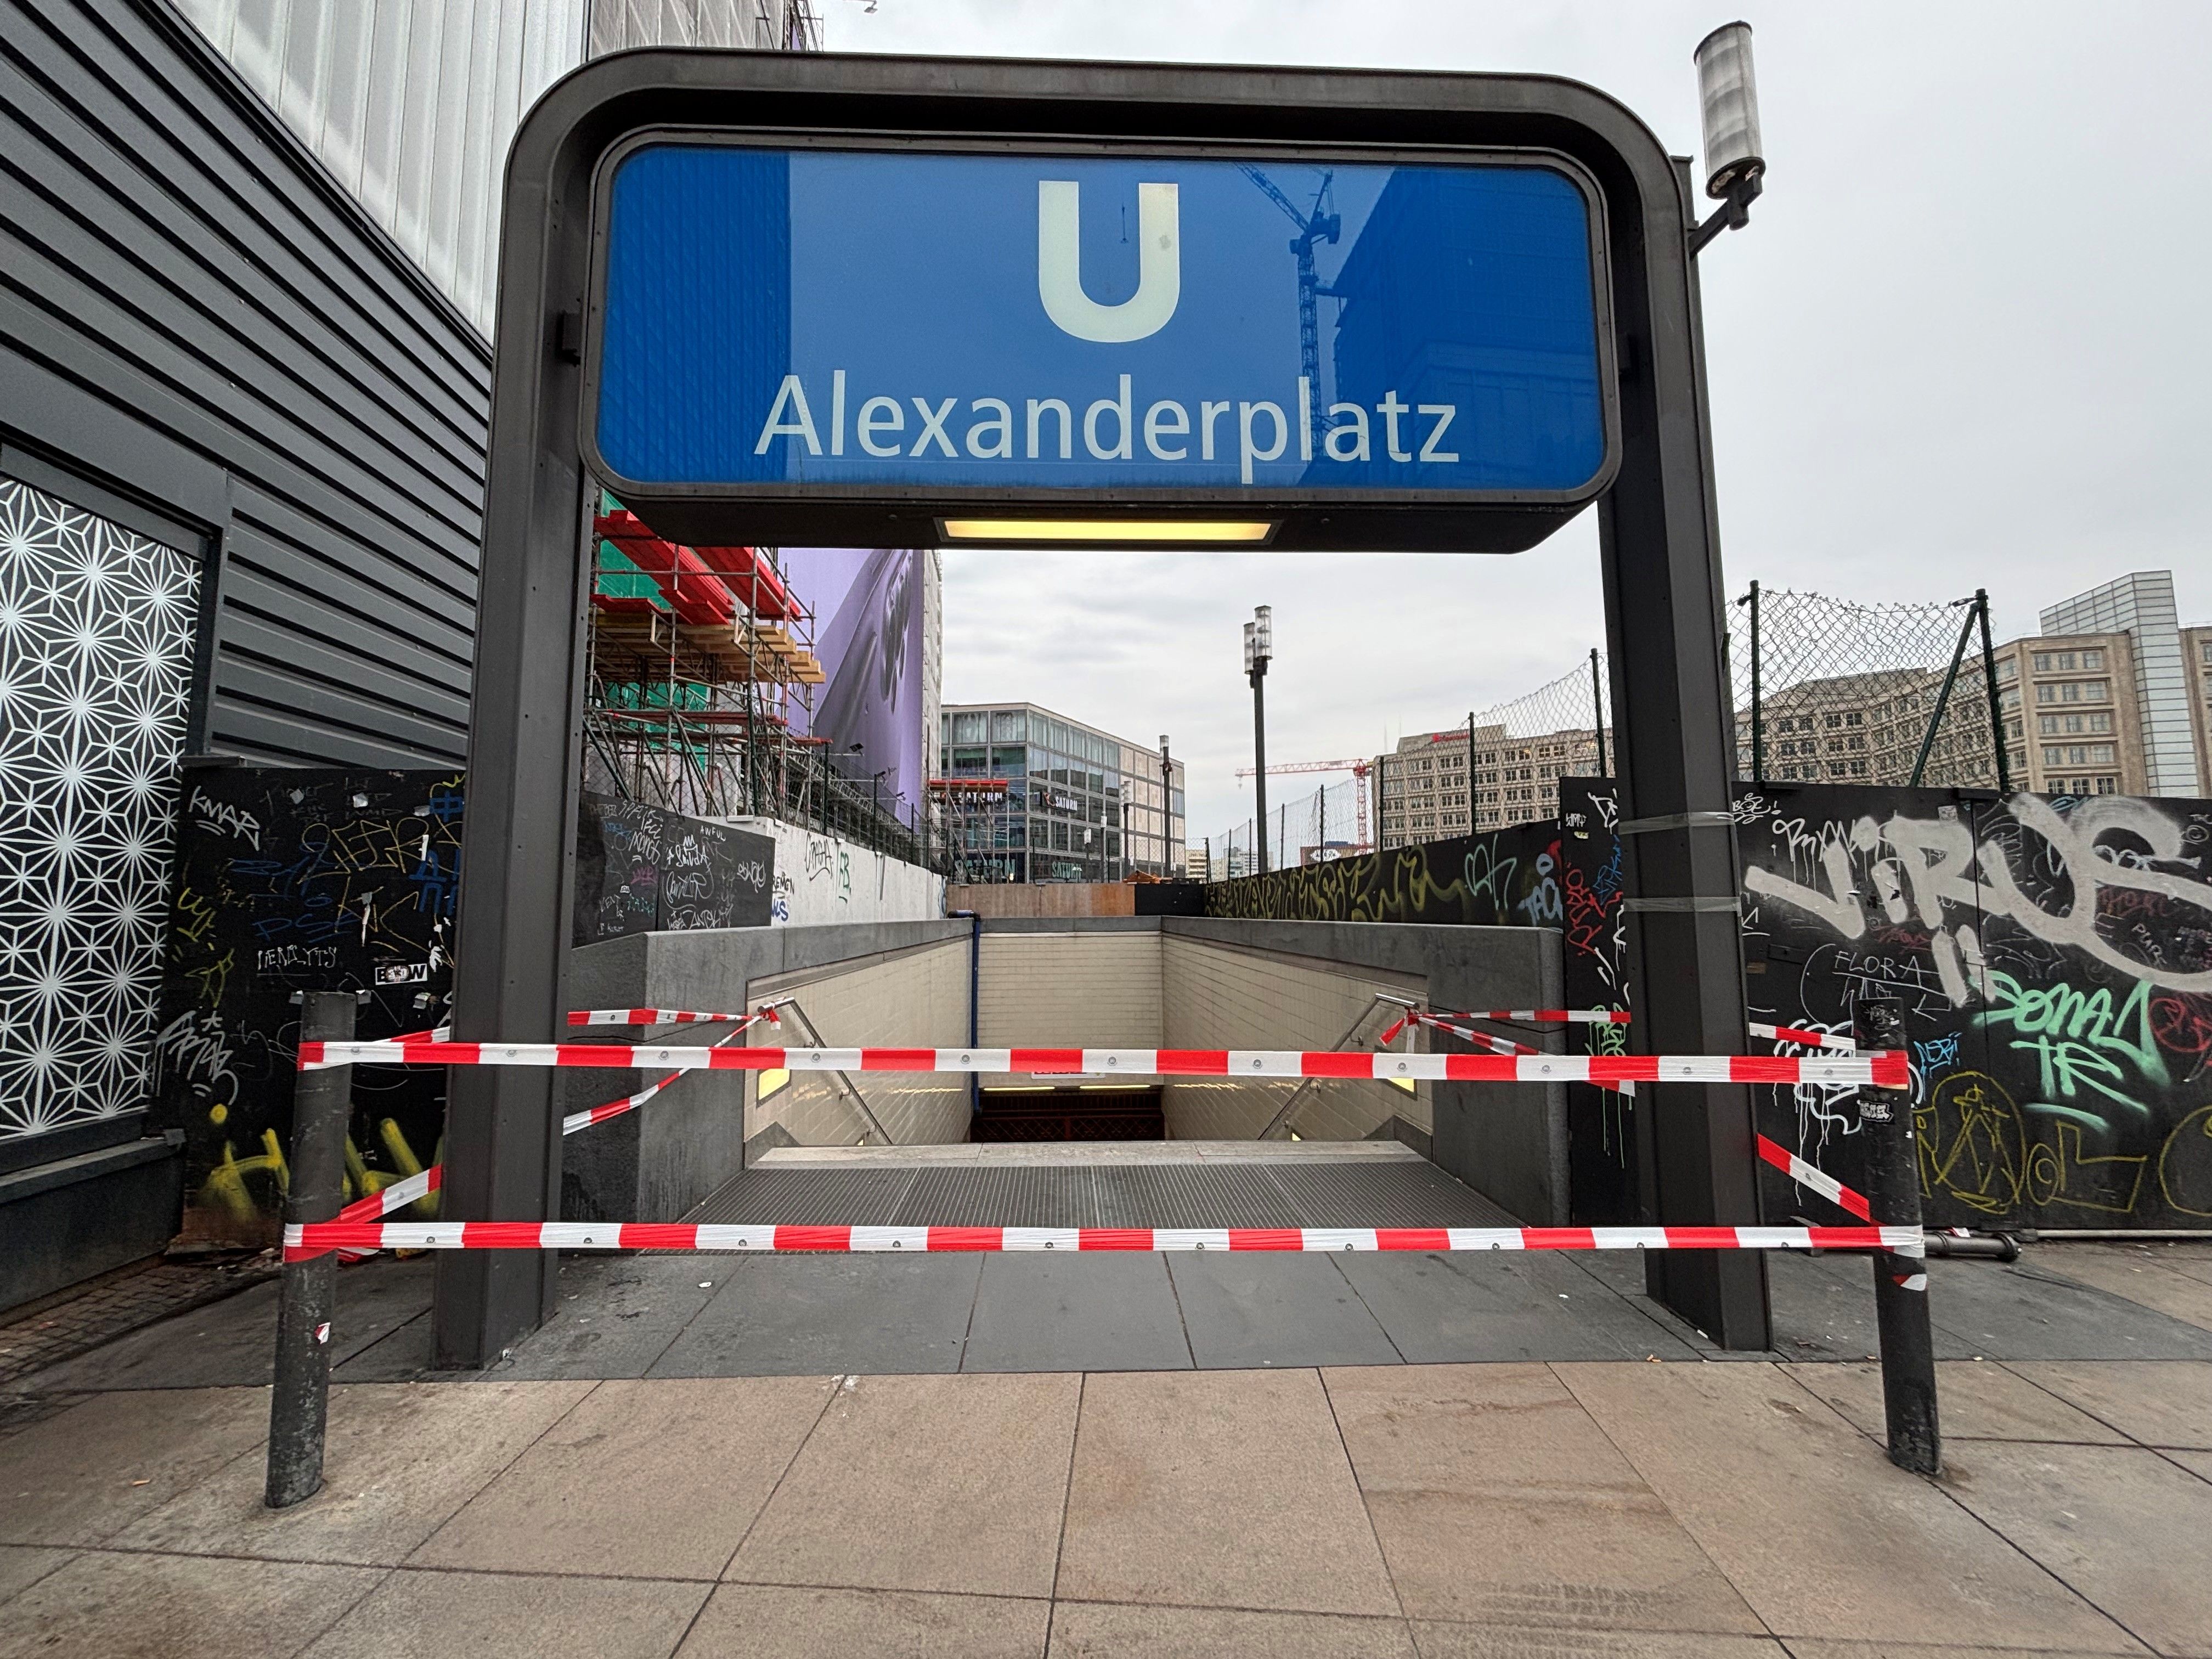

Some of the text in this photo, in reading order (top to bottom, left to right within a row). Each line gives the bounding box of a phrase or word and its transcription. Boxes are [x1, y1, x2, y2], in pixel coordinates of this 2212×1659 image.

[1039, 180, 1180, 343] U
[754, 369, 1460, 486] Alexanderplatz
[1055, 795, 1078, 811] SATURN
[1052, 861, 1081, 879] SATURN
[1835, 951, 1922, 988] FLORA
